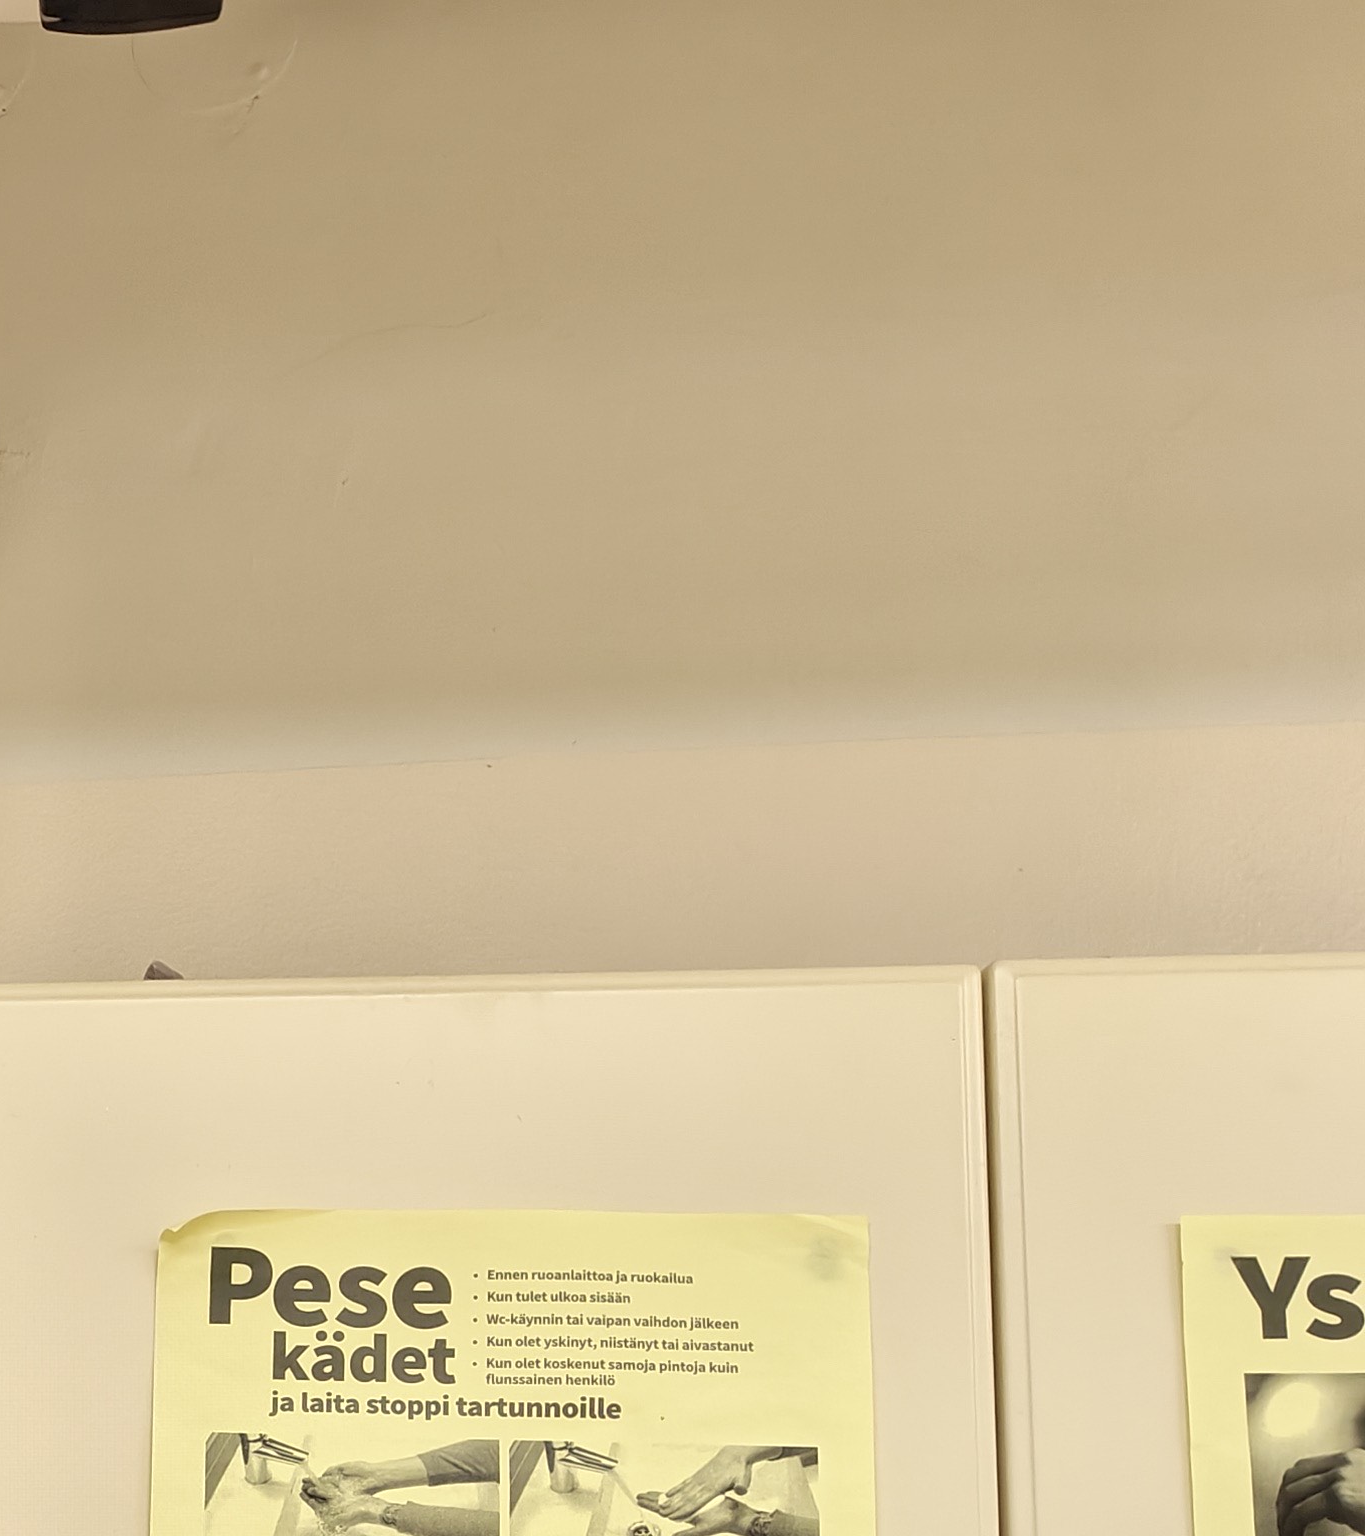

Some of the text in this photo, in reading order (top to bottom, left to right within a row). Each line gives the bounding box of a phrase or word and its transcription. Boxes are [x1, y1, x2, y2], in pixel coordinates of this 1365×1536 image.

[487, 1269, 694, 1285] Ennen ruoanlaittoa ja ruokailua
[208, 1246, 452, 1330] Pese
[487, 1290, 631, 1304] Kun tulet ulkoa sisään
[1230, 1256, 1365, 1340] Ys
[486, 1313, 739, 1332] Wc-käynnin tai vaipan vaihdon jälkeen
[486, 1335, 754, 1353] Kun olet yskinyt, niistänyt tai aivastanut
[272, 1330, 456, 1385] kädet
[486, 1357, 739, 1375] Kun olet koskenut samoja pintoja kuin
[485, 1373, 616, 1386] flunssainen henkilö
[268, 1390, 622, 1421] ja laita stoppi tartunnoille
